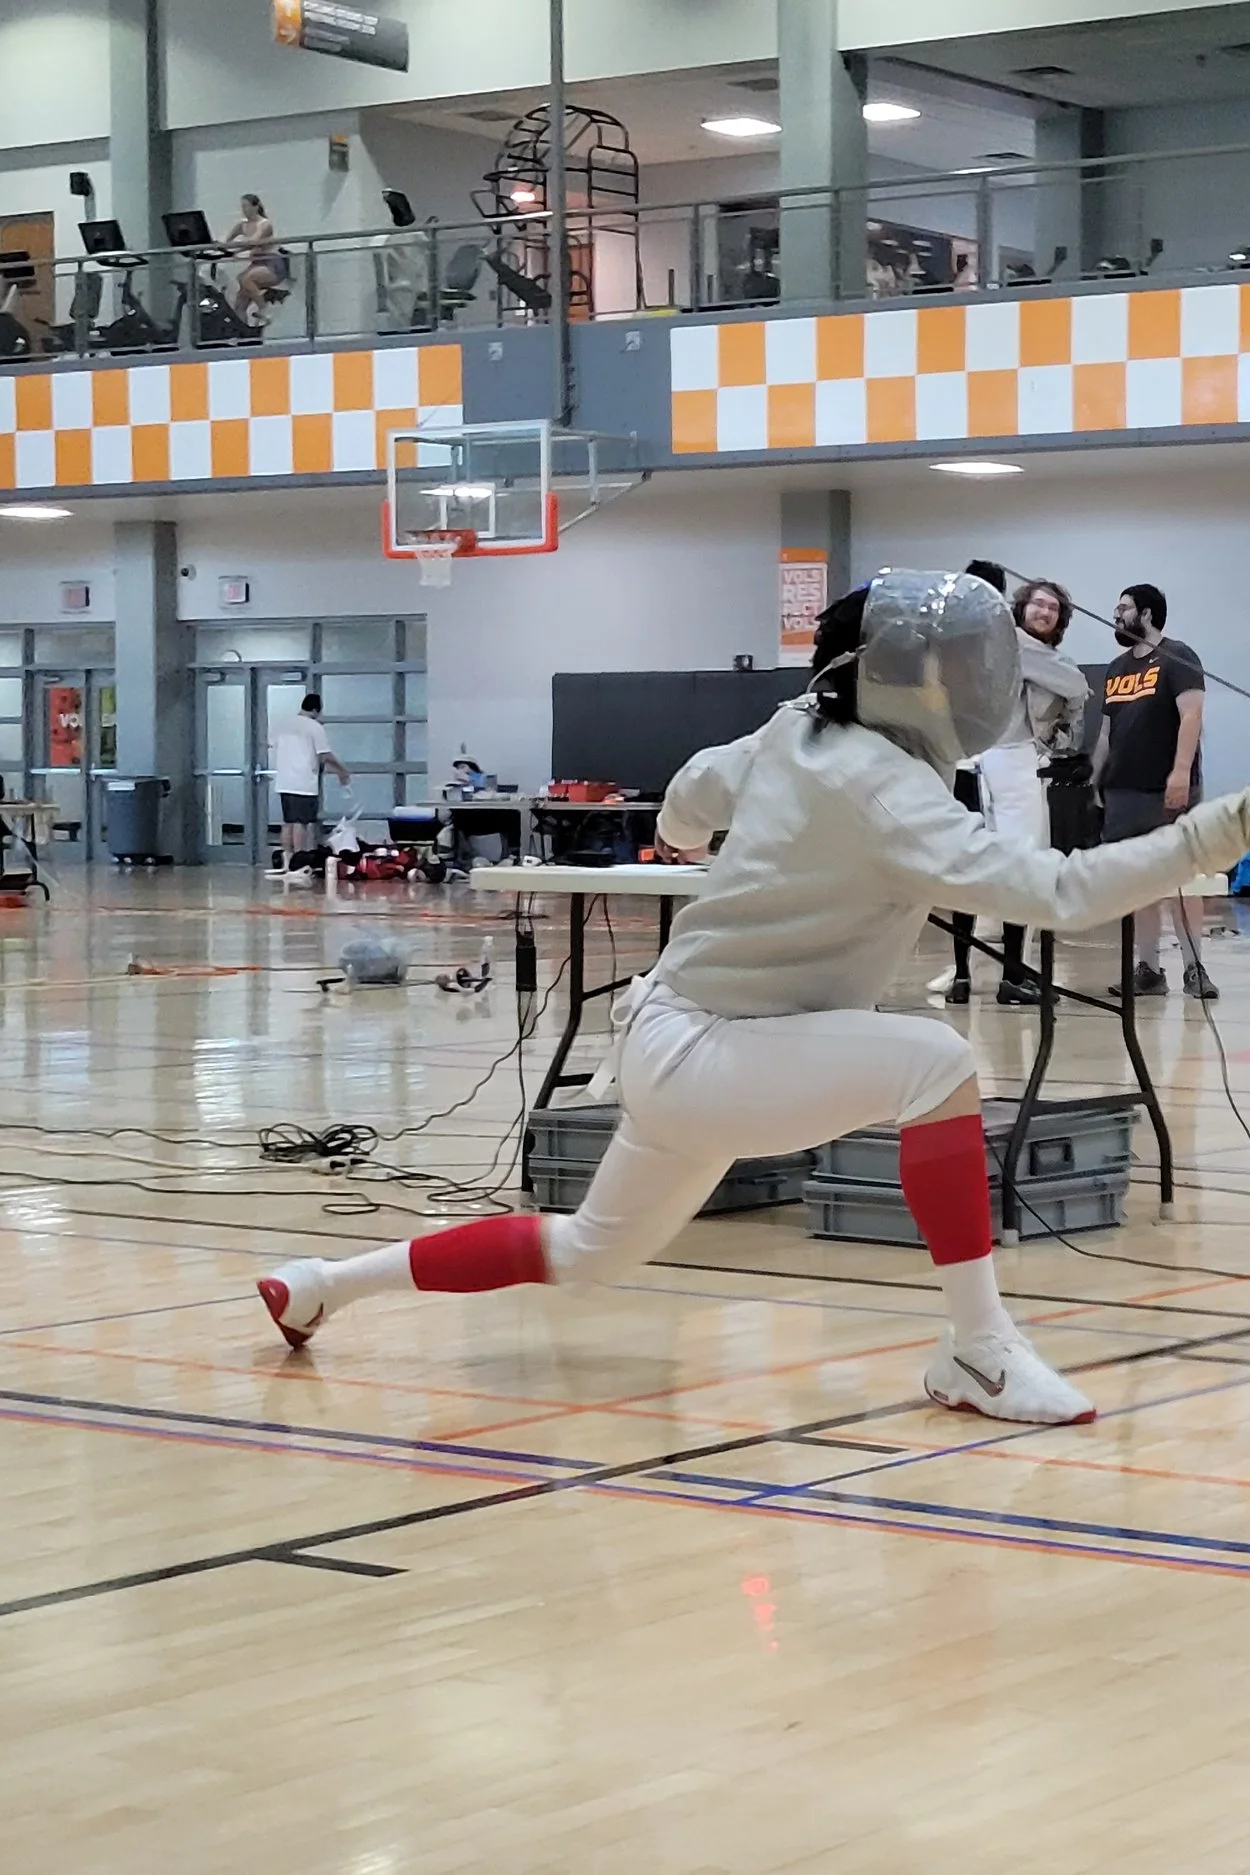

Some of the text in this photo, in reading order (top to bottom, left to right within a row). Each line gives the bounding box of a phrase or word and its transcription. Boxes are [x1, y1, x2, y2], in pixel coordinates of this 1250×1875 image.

[783, 569, 821, 583] VOLS
[783, 584, 821, 602] RES
[1106, 666, 1161, 696] VOLS
